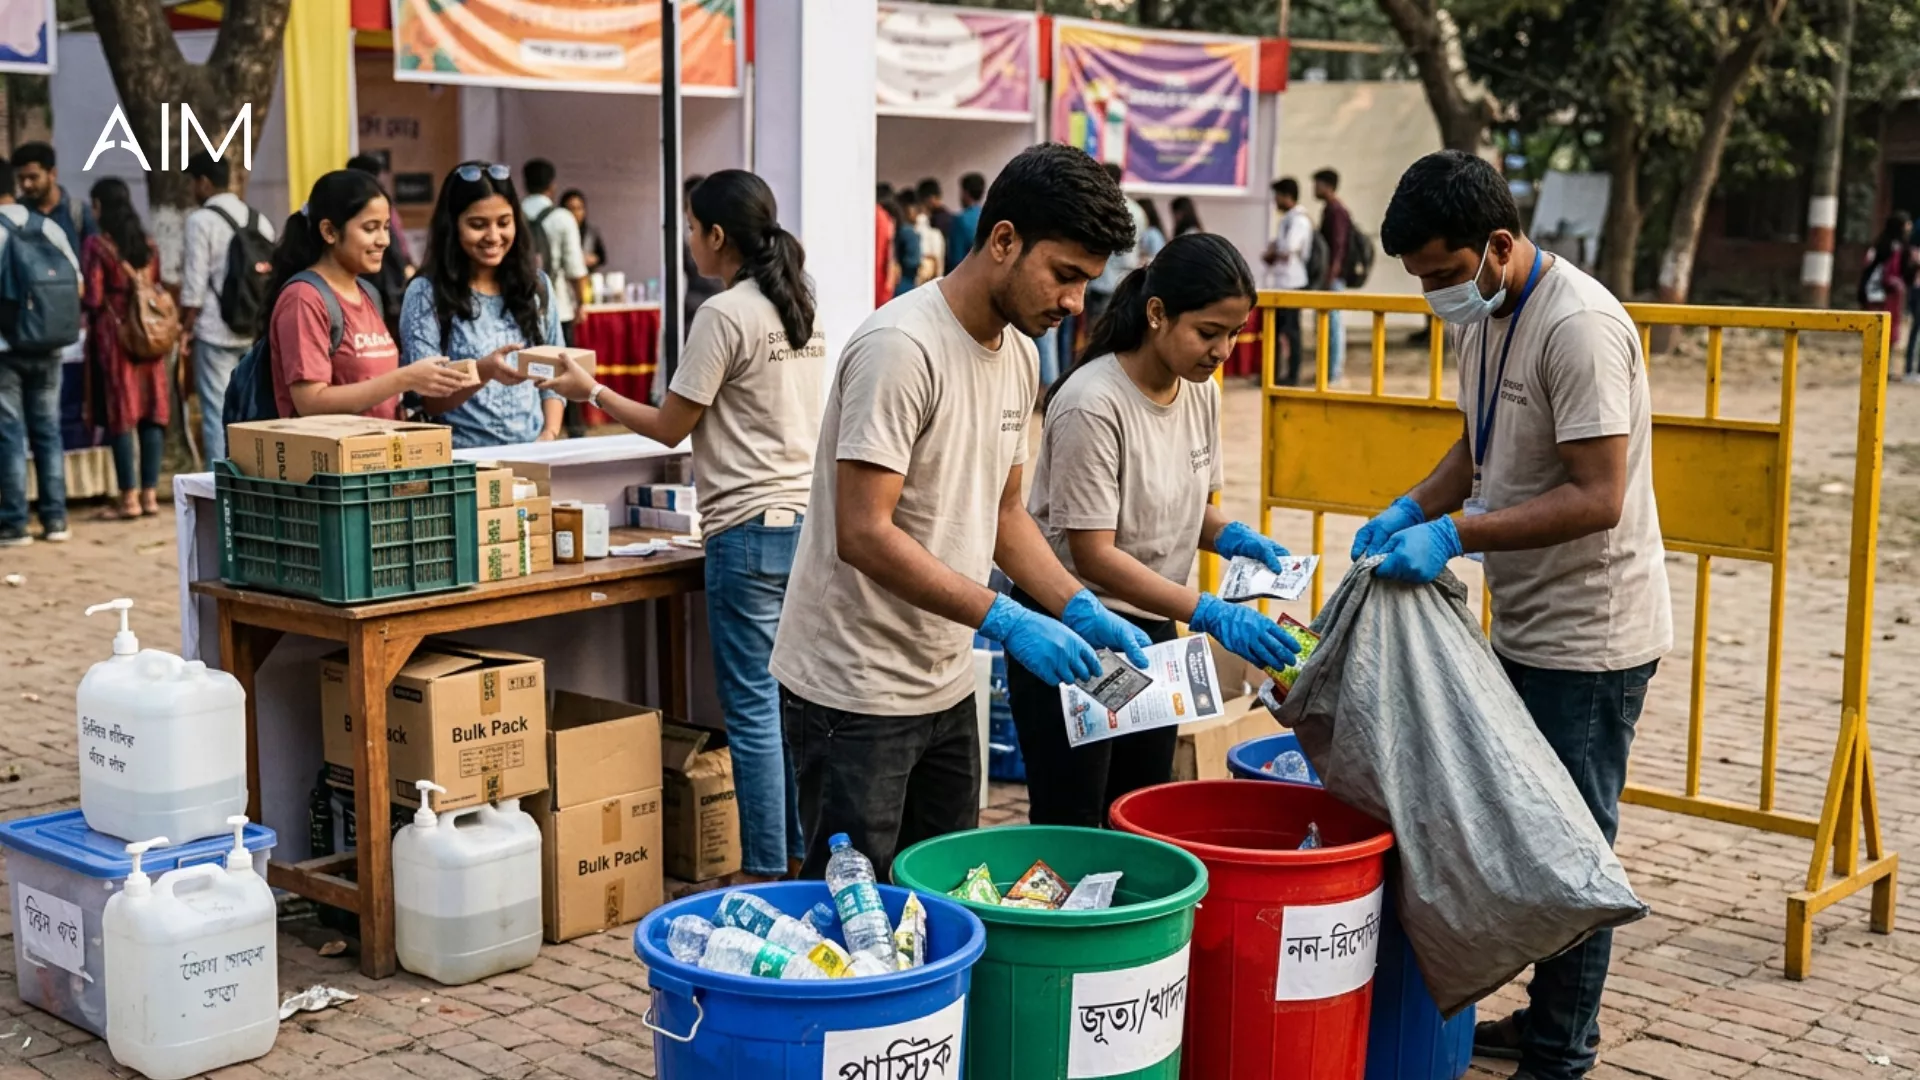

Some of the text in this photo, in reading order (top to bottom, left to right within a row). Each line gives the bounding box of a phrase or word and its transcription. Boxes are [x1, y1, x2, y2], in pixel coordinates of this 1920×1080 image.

[387, 725, 408, 744] ack
[452, 716, 529, 743] Bulk Pack
[578, 845, 649, 876] Bulk Pack
